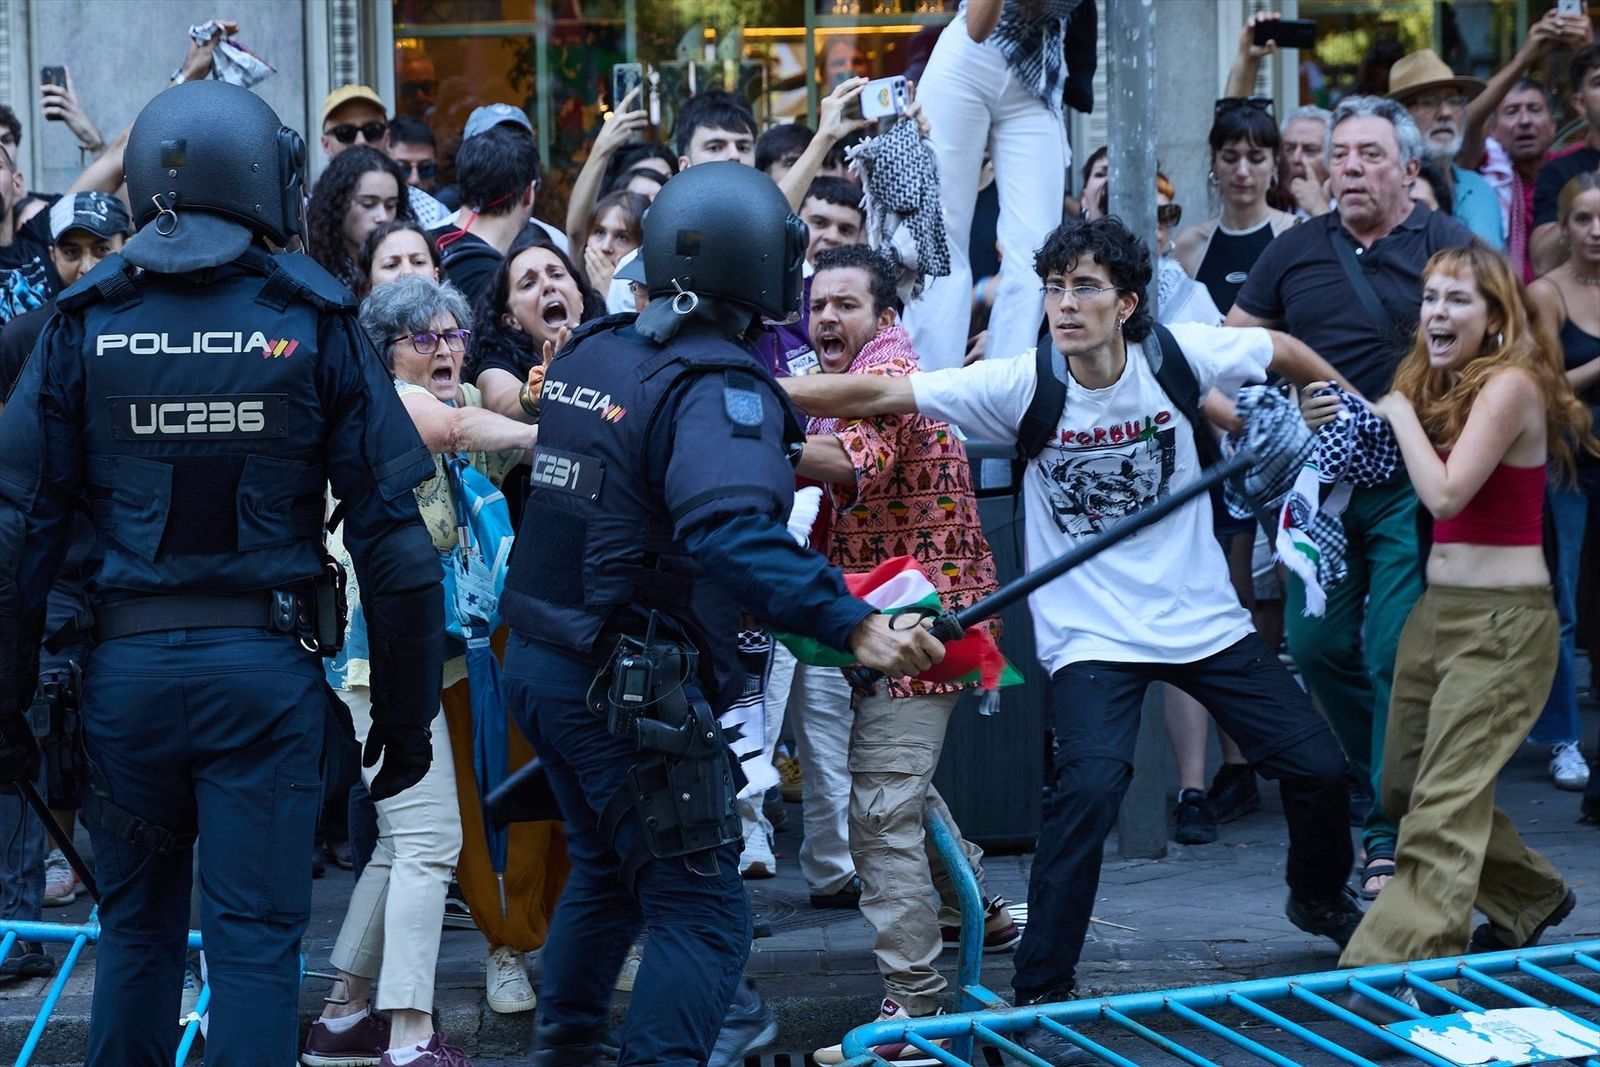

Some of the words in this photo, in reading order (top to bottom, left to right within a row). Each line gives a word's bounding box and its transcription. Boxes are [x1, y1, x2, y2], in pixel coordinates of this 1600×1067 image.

[96, 331, 272, 356] POLICIA
[542, 380, 612, 412] POLICIA
[130, 401, 265, 434] UC236
[533, 452, 580, 490] C231
